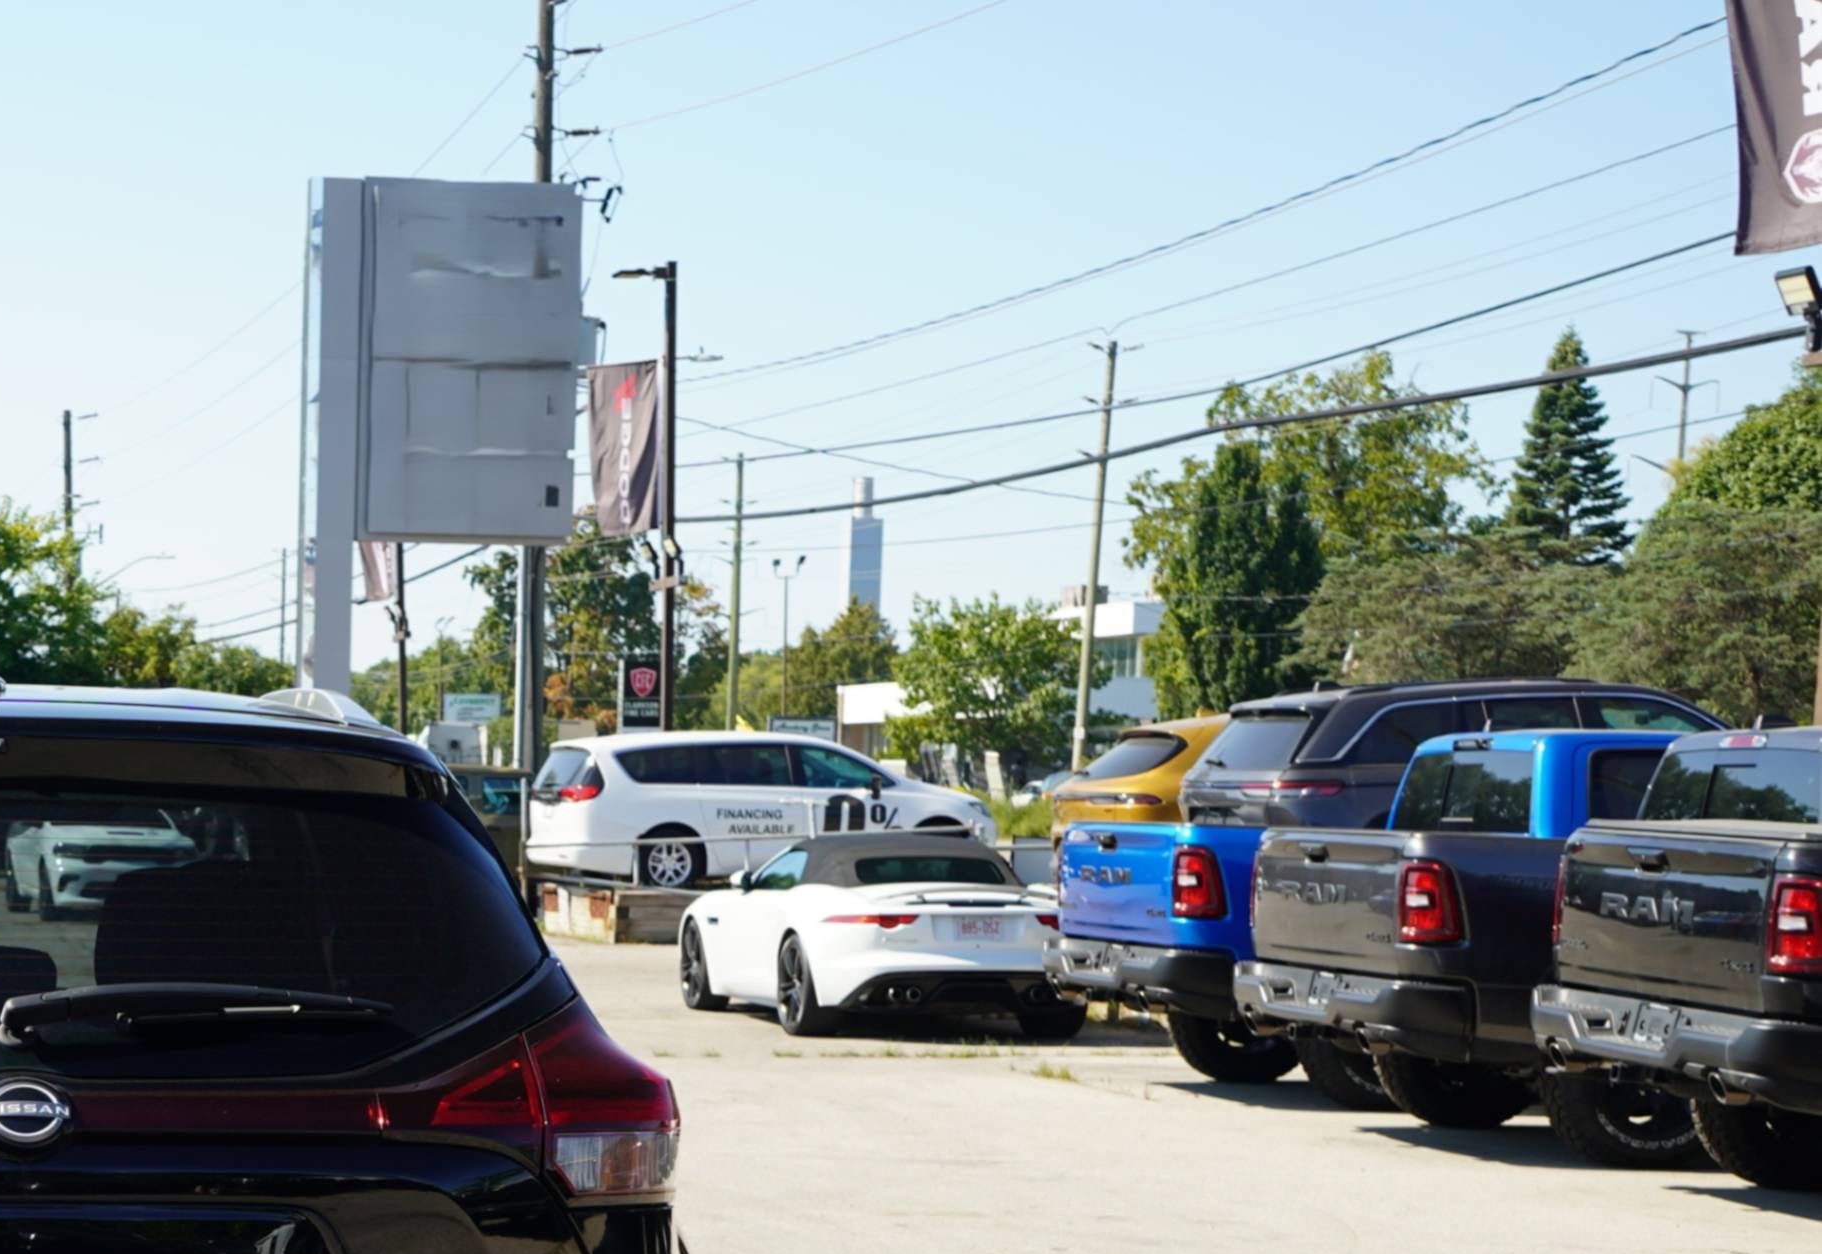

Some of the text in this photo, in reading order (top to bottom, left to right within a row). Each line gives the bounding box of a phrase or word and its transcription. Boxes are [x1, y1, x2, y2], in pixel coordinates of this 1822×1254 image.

[716, 808, 783, 819] FINANCING
[728, 824, 795, 834] AVAILABLE
[1080, 865, 1132, 887] RAM
[1277, 880, 1347, 904] RAM
[1599, 891, 1695, 928] RAM
